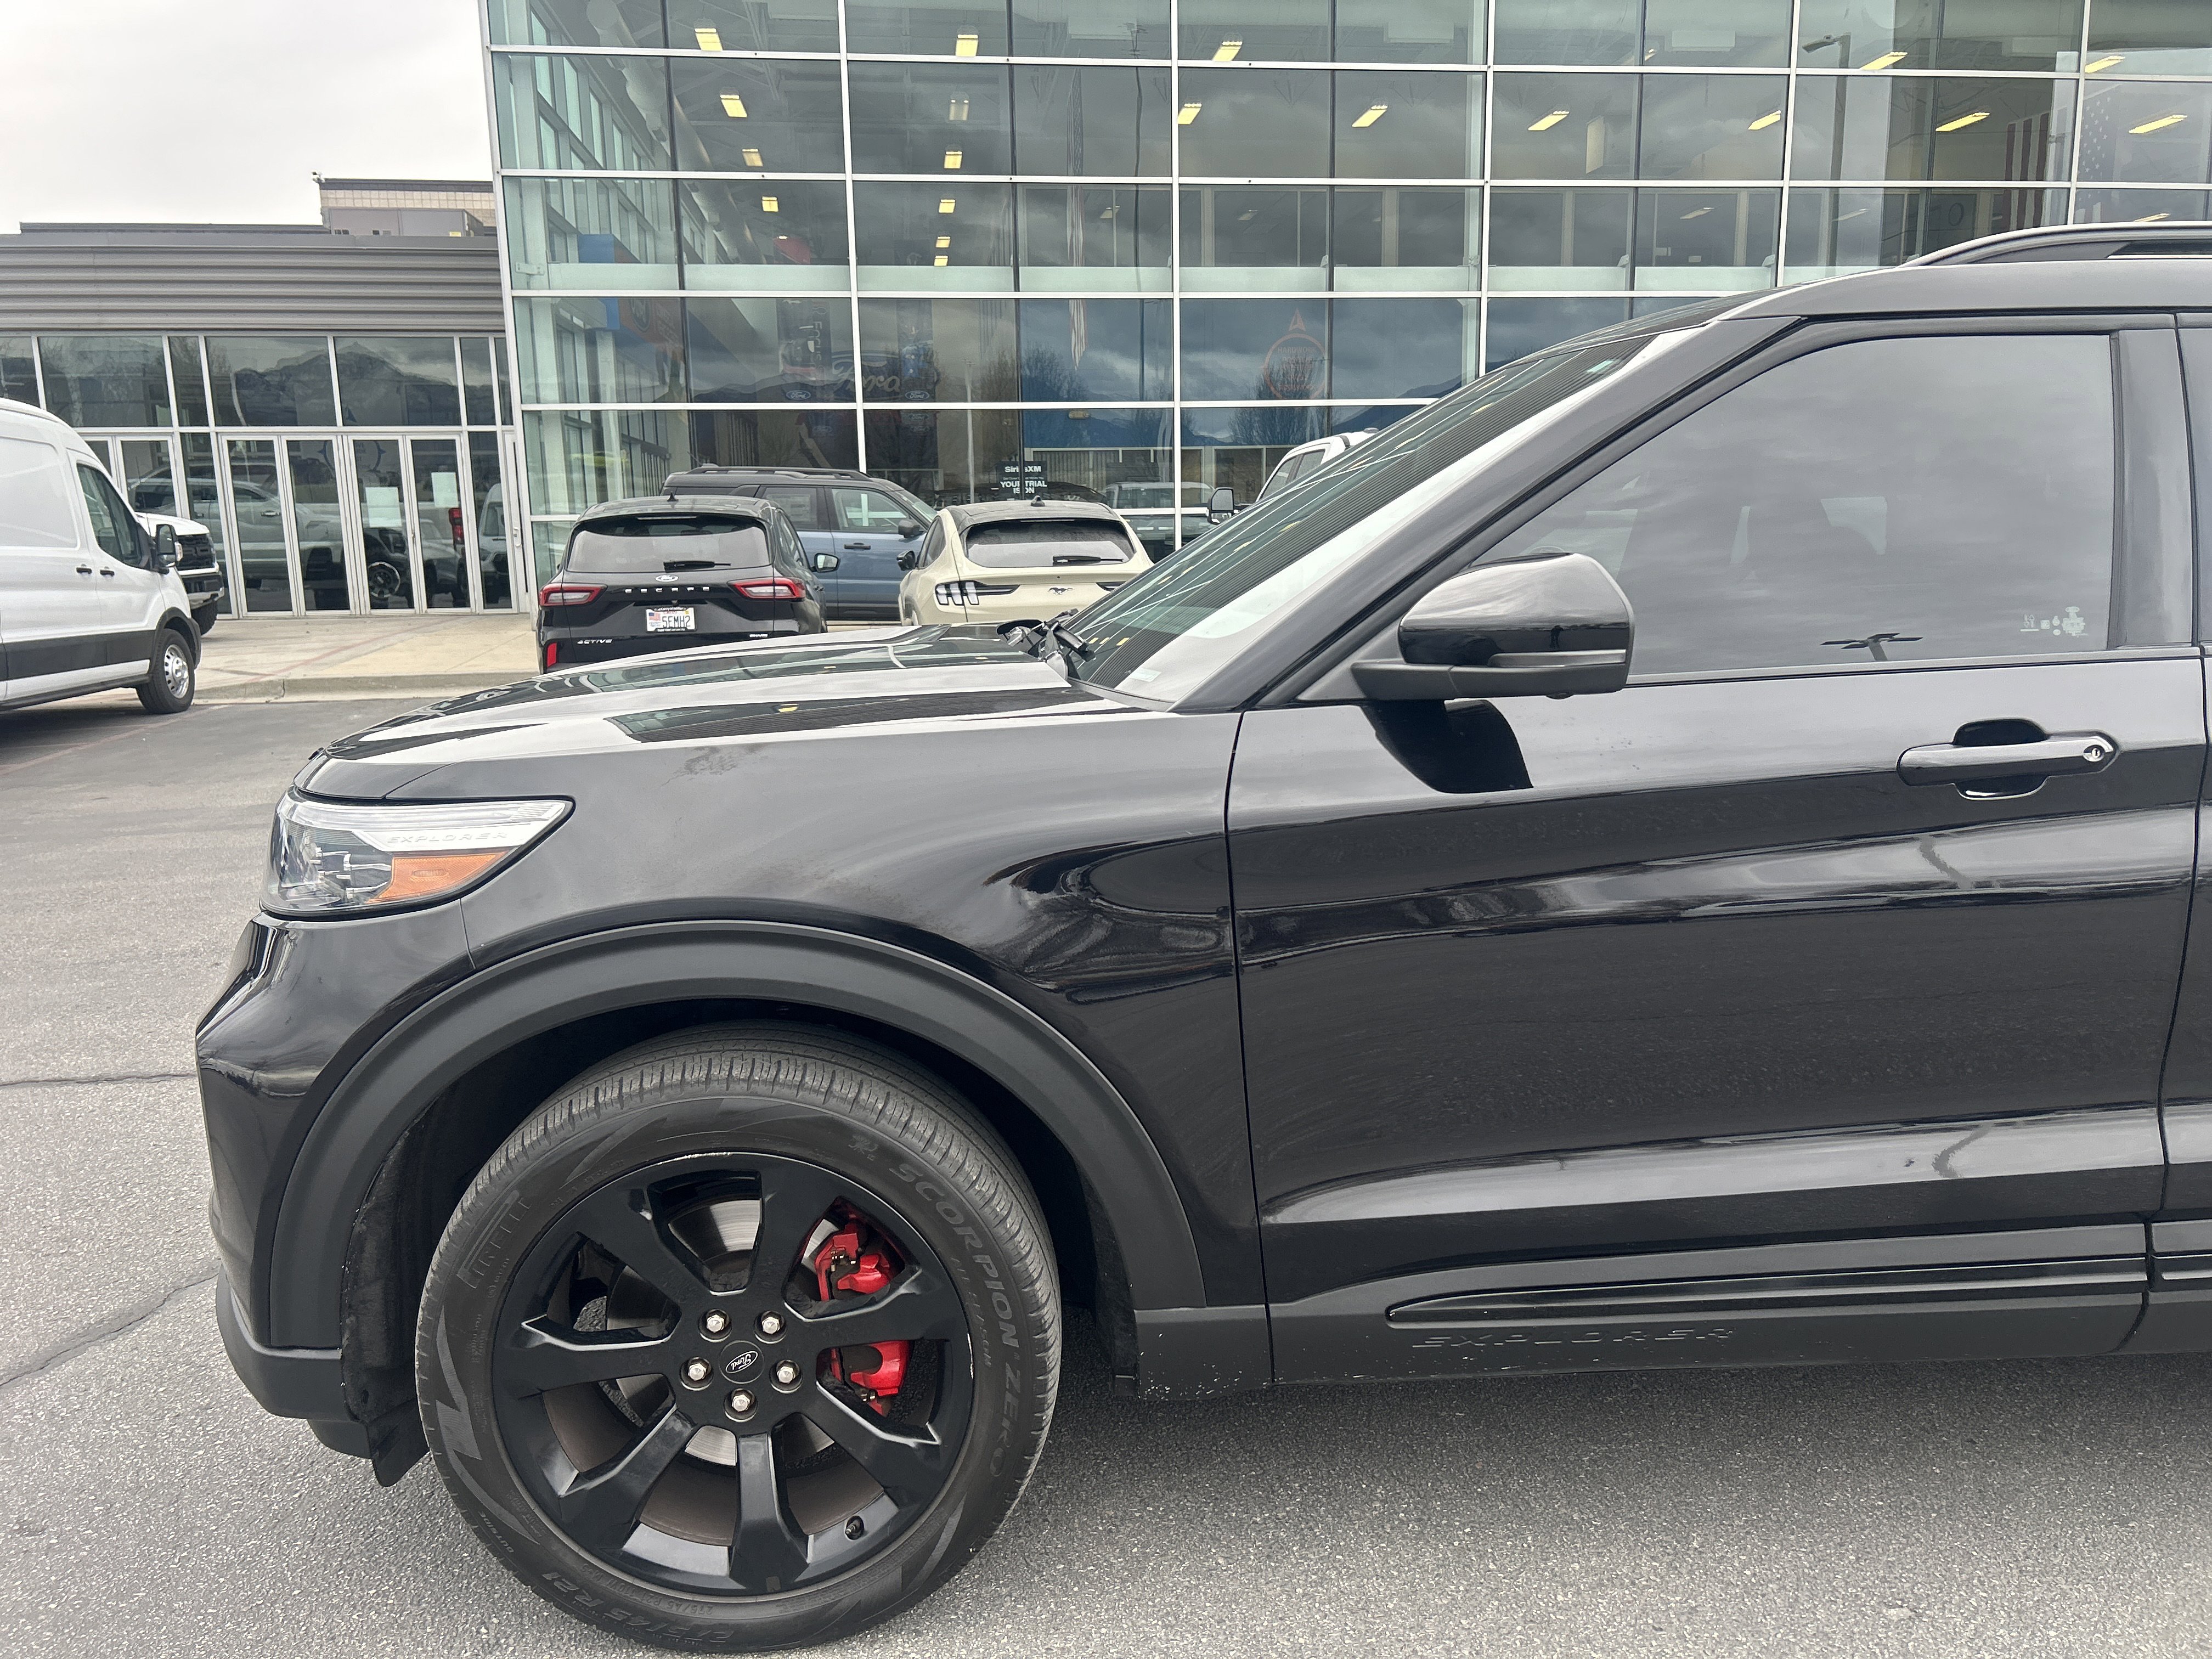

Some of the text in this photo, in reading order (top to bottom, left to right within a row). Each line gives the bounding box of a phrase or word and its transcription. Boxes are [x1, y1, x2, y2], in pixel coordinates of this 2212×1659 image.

[387, 832, 507, 843] EXPLORER
[456, 1189, 532, 1289] PIRELLI
[889, 1163, 1021, 1477] SCORPION ZERO
[1412, 1328, 1733, 1347] EXPLORER
[729, 1353, 752, 1371] Ford
[479, 1511, 515, 1554] OUTSIDE
[541, 1571, 605, 1607] R21
